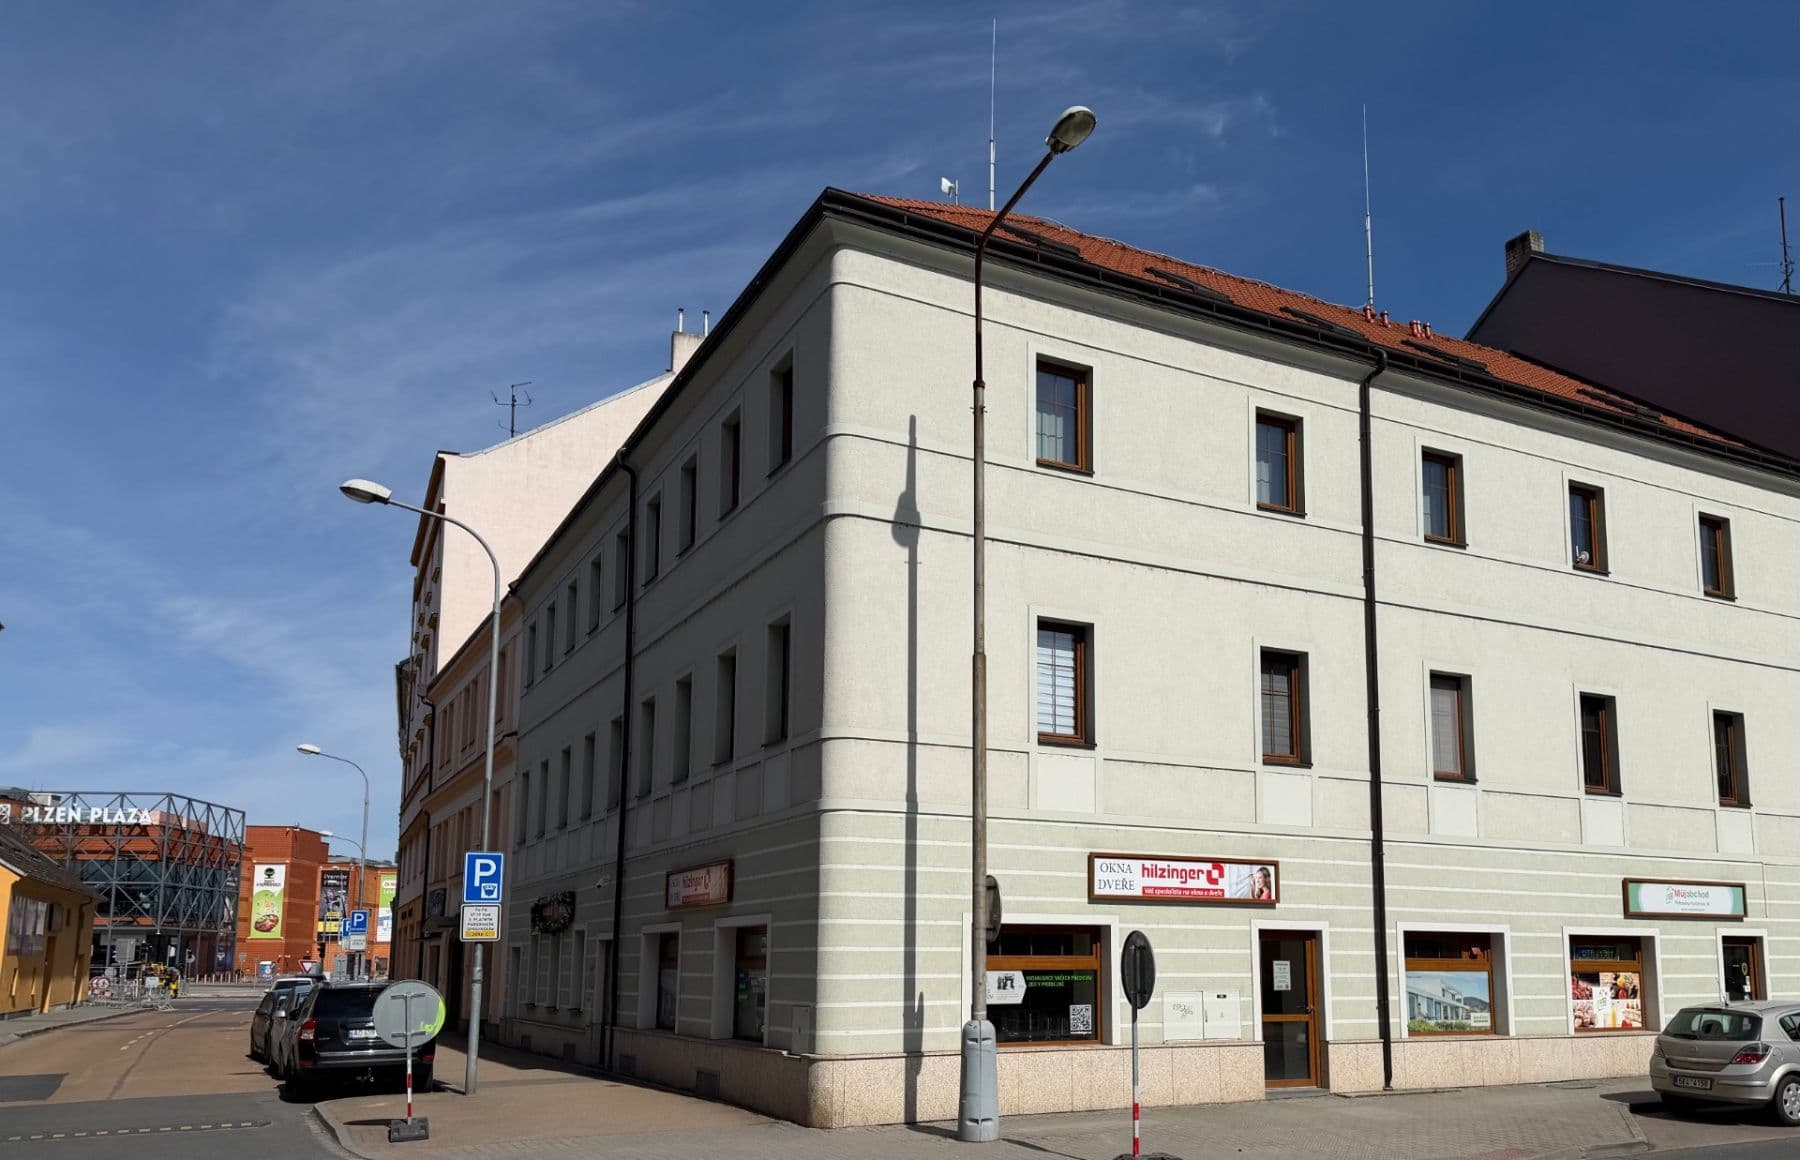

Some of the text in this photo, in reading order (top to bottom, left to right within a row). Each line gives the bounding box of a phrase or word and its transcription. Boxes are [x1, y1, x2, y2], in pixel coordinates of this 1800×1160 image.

[22, 802, 152, 825] PLZEŇ PLAZA
[474, 858, 497, 887] P
[1099, 863, 1133, 874] OKNA
[1141, 863, 1205, 884] hilzinger
[1097, 878, 1135, 891] DVEŘE
[353, 913, 365, 927] P
